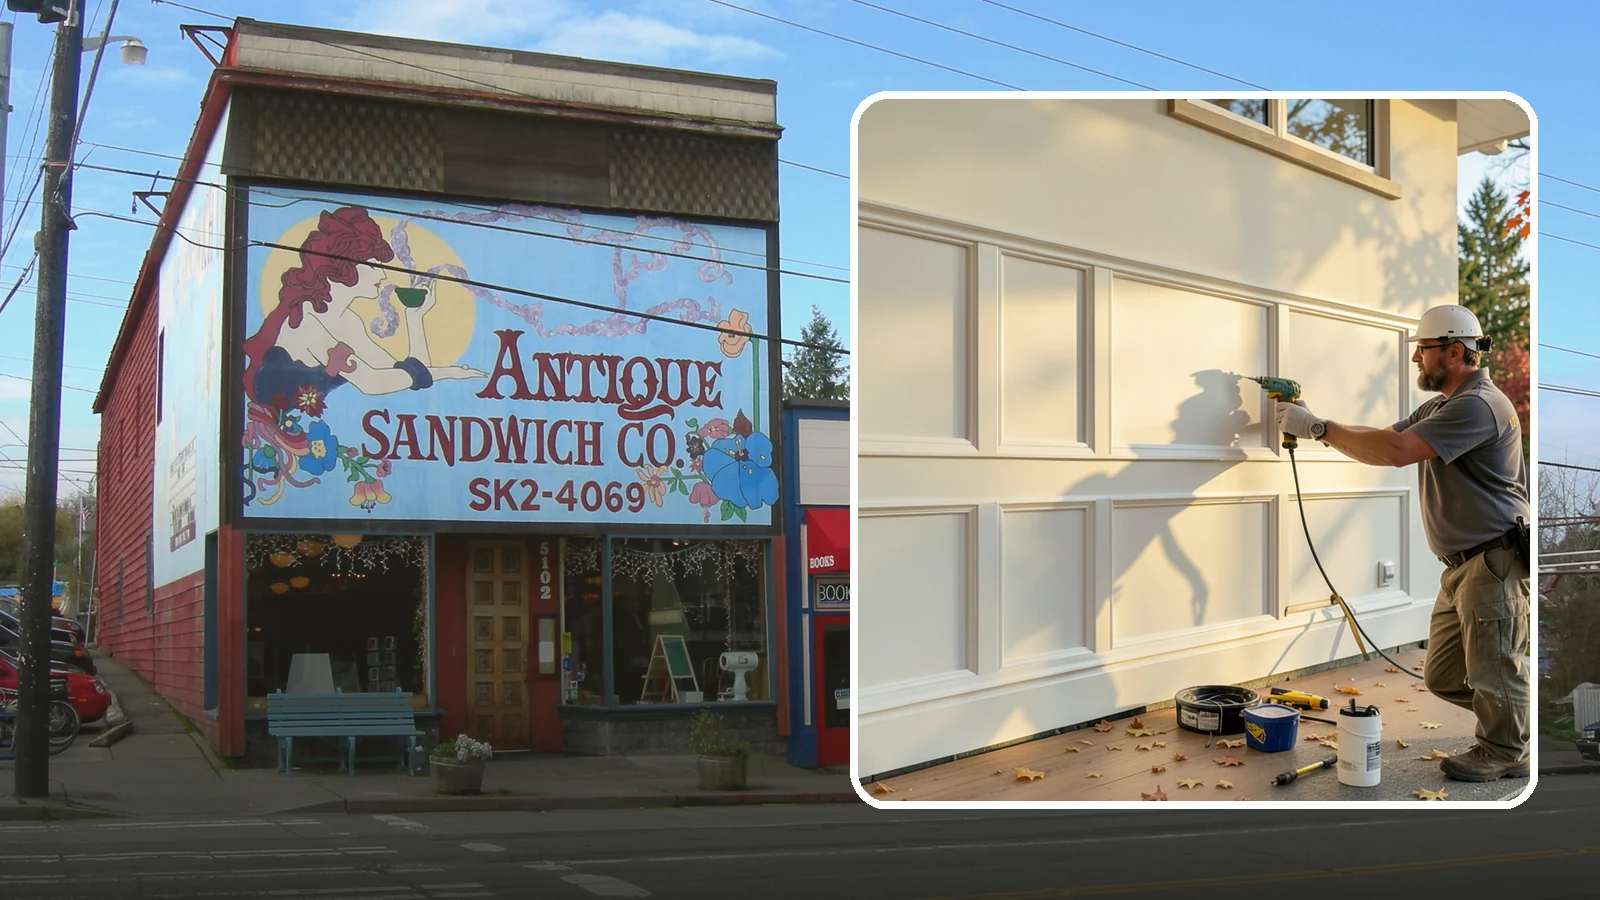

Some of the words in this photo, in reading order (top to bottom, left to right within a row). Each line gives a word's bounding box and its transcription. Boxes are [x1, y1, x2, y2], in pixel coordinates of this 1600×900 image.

[476, 329, 723, 420] ANTIQUE
[361, 408, 604, 468] SANDWICH
[617, 421, 685, 468] CO.
[468, 477, 646, 513] SK2-4069
[539, 542, 552, 600] 5102
[809, 555, 835, 569] BOOKS
